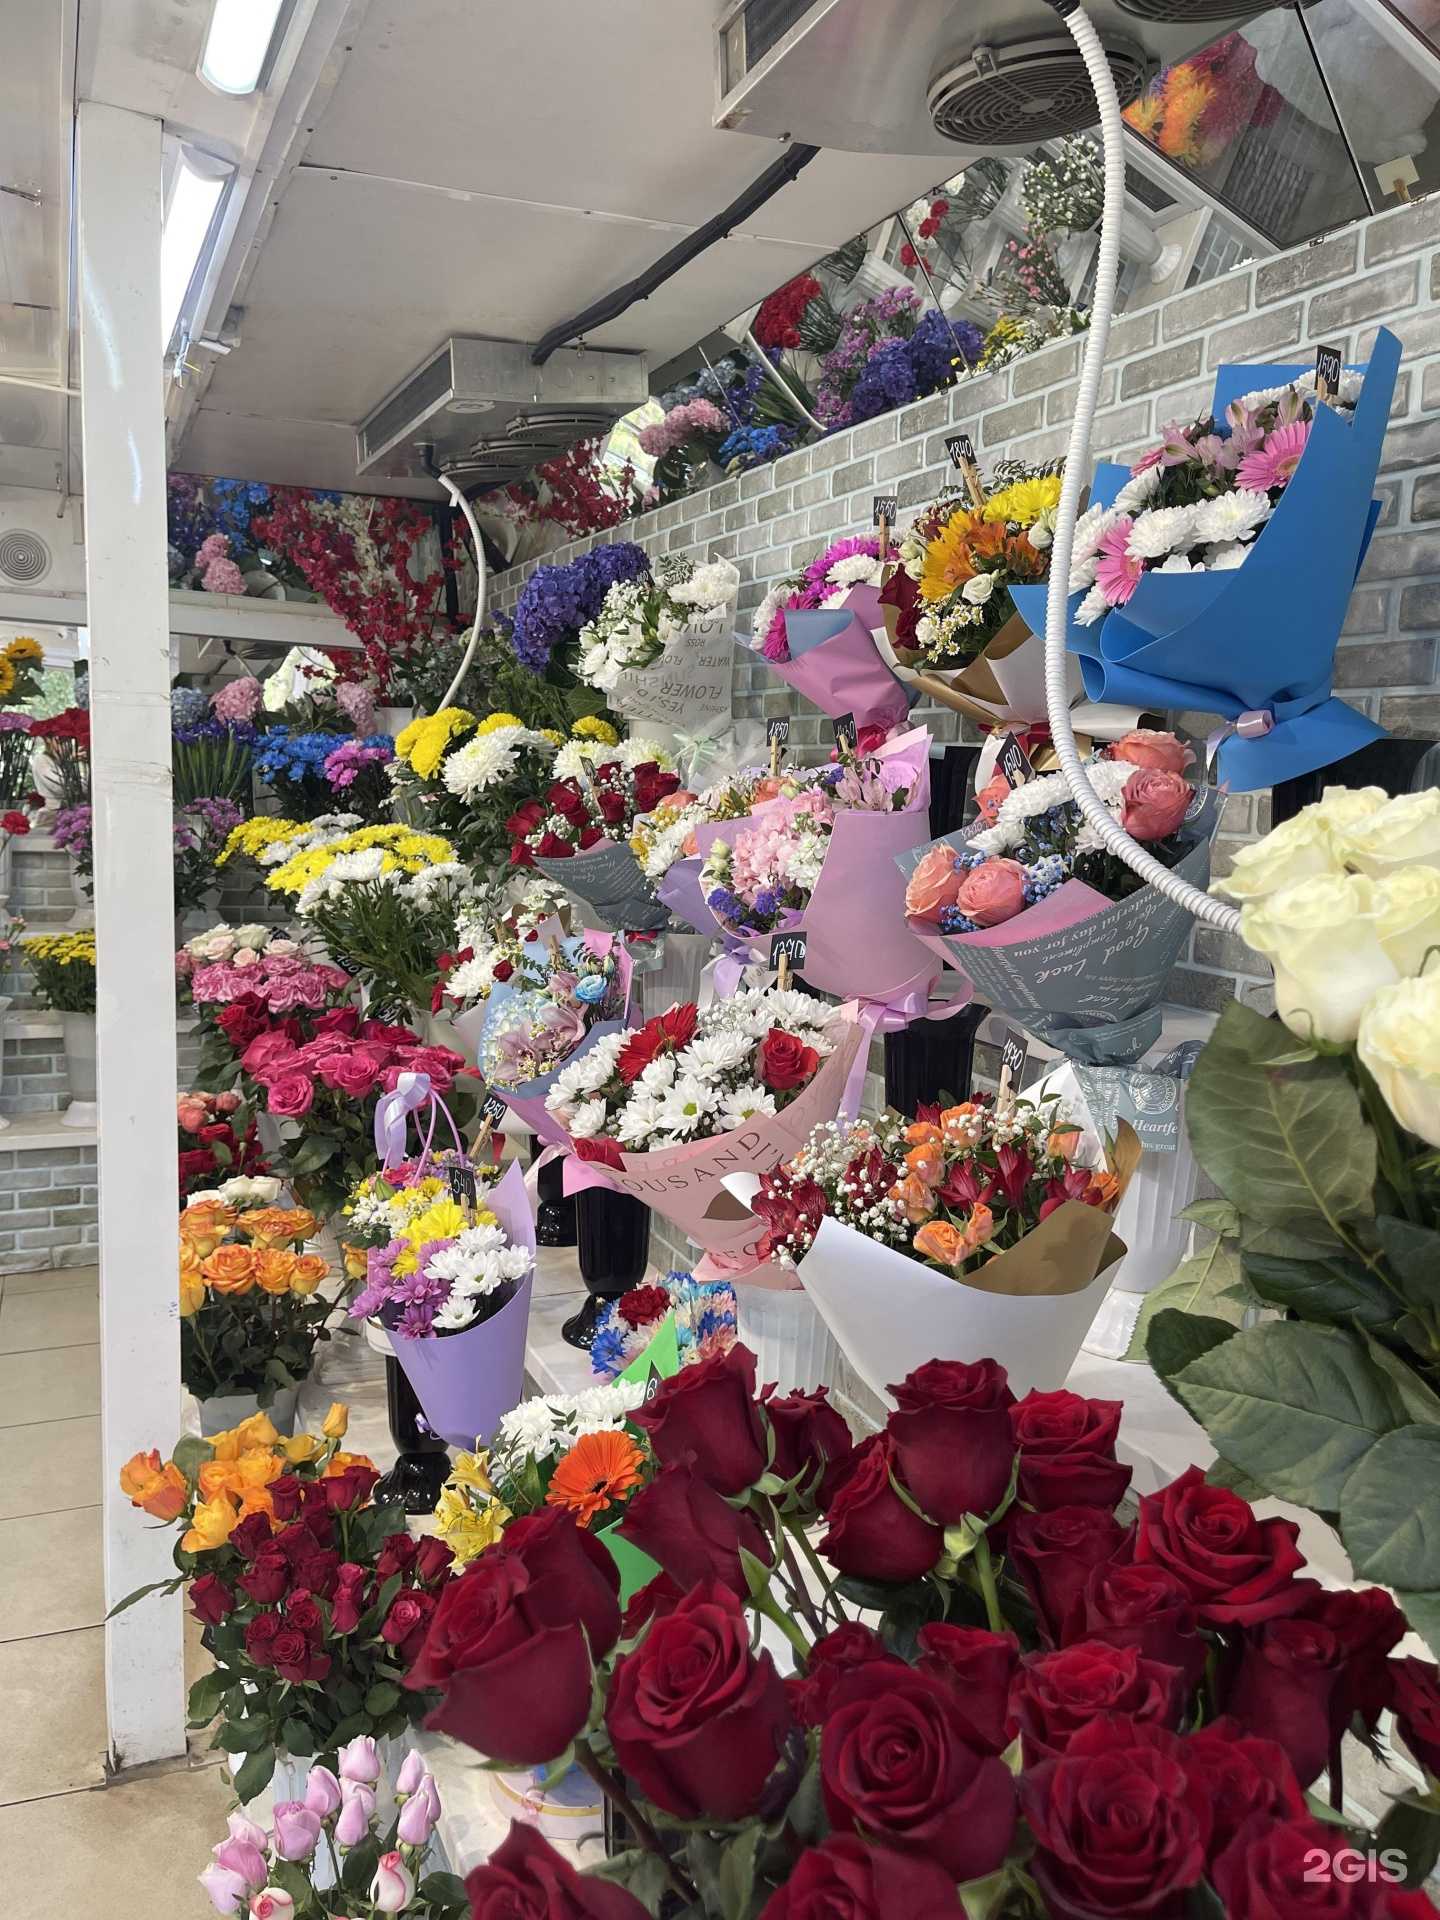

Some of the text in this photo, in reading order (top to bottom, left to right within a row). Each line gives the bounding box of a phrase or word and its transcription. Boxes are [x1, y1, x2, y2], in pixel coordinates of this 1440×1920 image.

[949, 440, 973, 462] 1840
[661, 681, 724, 699] FLOWER
[1013, 944, 1041, 958] you
[1046, 935, 1067, 951] for
[1103, 923, 1149, 965] Good
[1034, 957, 1087, 984] Luck
[483, 1097, 506, 1120] 1250
[621, 1132, 762, 1194] OUSAND
